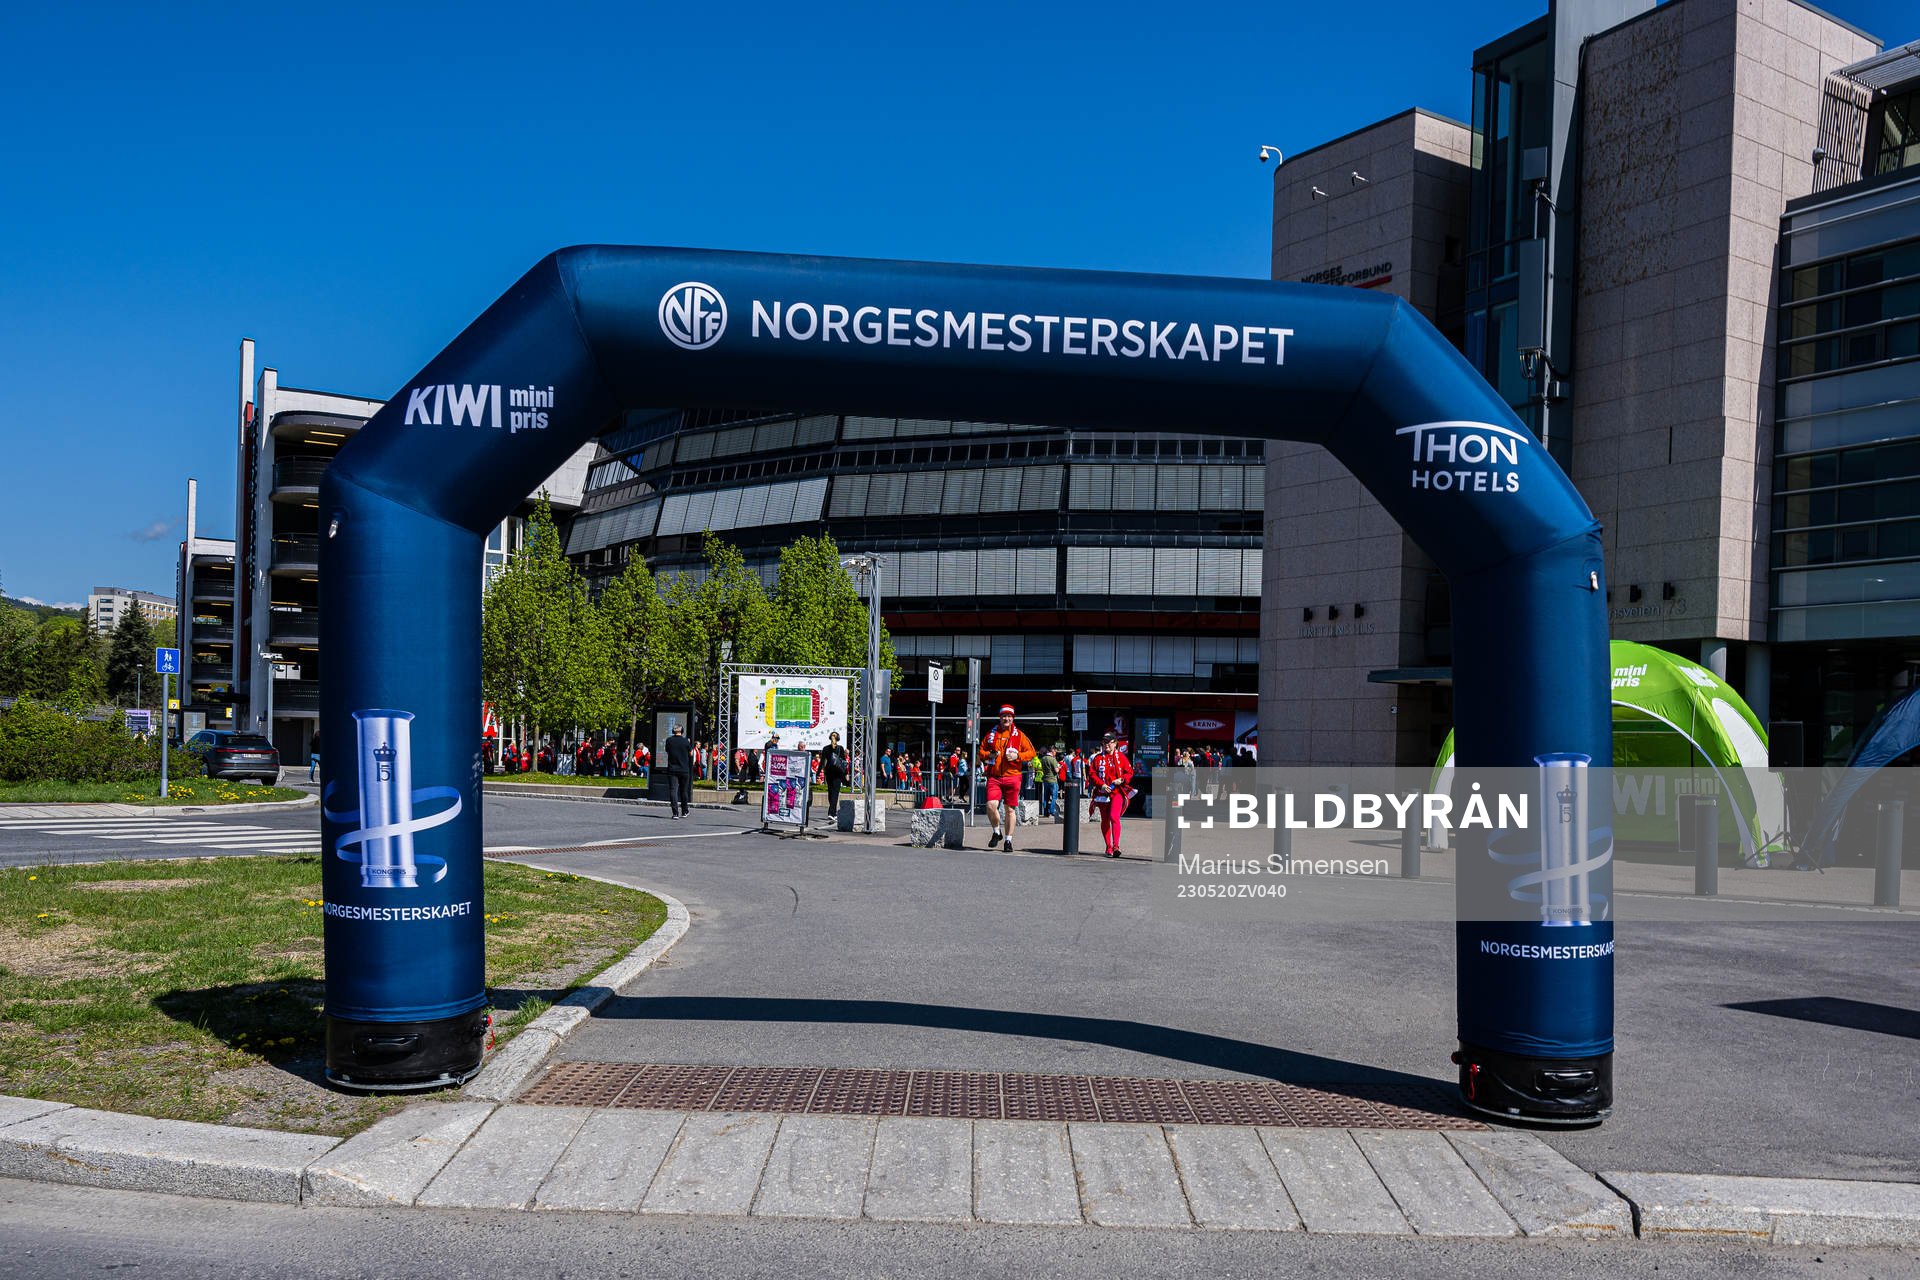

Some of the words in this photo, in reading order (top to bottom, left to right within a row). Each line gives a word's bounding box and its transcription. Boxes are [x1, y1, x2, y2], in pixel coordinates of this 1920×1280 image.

[752, 299, 1294, 366] NORGESMESTERSKAPET
[404, 384, 502, 428] KIWI
[509, 385, 554, 408] mini
[510, 408, 549, 433] pris
[1396, 421, 1529, 465] THON
[1412, 470, 1519, 493] HOTELS
[1614, 664, 1648, 677] mini
[1611, 677, 1641, 690] pris
[1613, 774, 1665, 816] WI
[1675, 773, 1720, 795] mini
